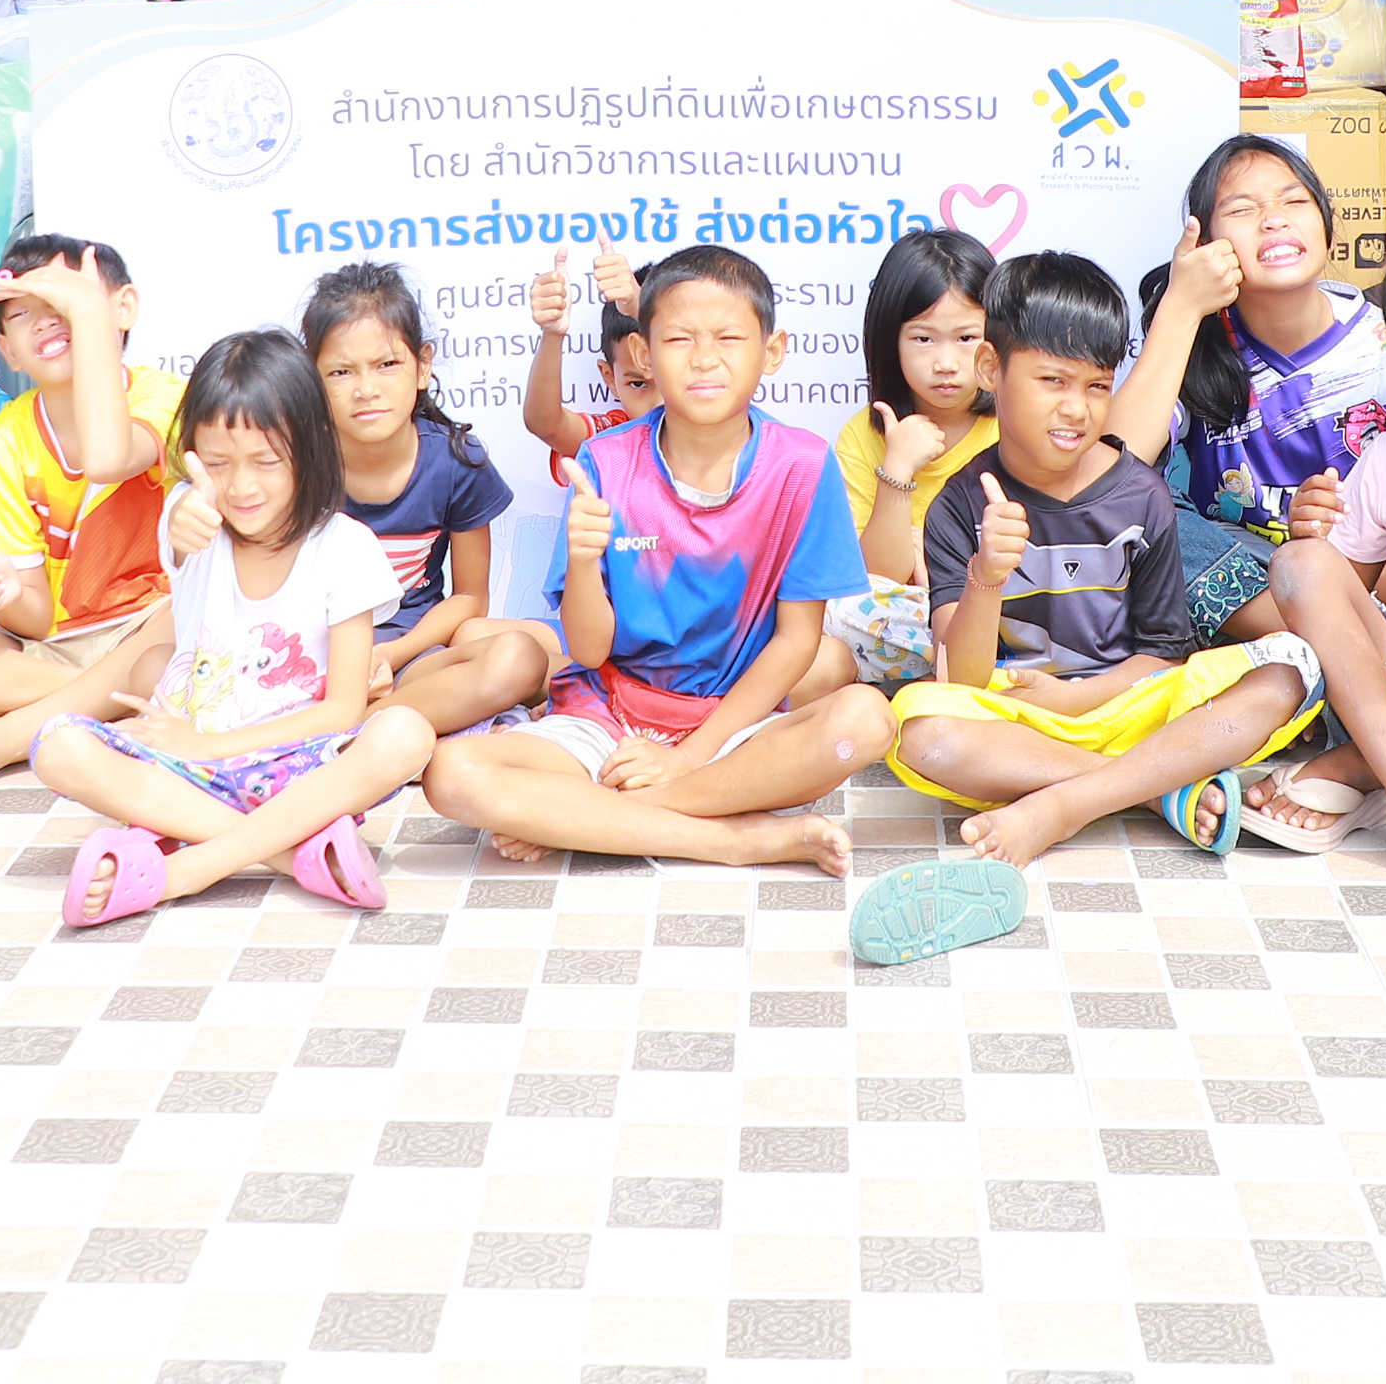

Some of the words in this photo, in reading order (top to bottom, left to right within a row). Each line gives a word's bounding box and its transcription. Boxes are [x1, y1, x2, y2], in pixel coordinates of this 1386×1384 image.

[332, 75, 998, 128] สำนักงานการปฏิรูปที่ดินเพื่อเกษตรกรรม
[409, 143, 470, 178] โดย
[484, 142, 902, 176] สำนักวิชาการและแผนงาน
[1040, 182, 1072, 190] Research
[1074, 182, 1081, 190] &
[1082, 182, 1114, 192] Planning
[1115, 183, 1140, 191] Bureau
[272, 197, 679, 255] โครงการส่งของใช้
[614, 536, 659, 552] SPORT
